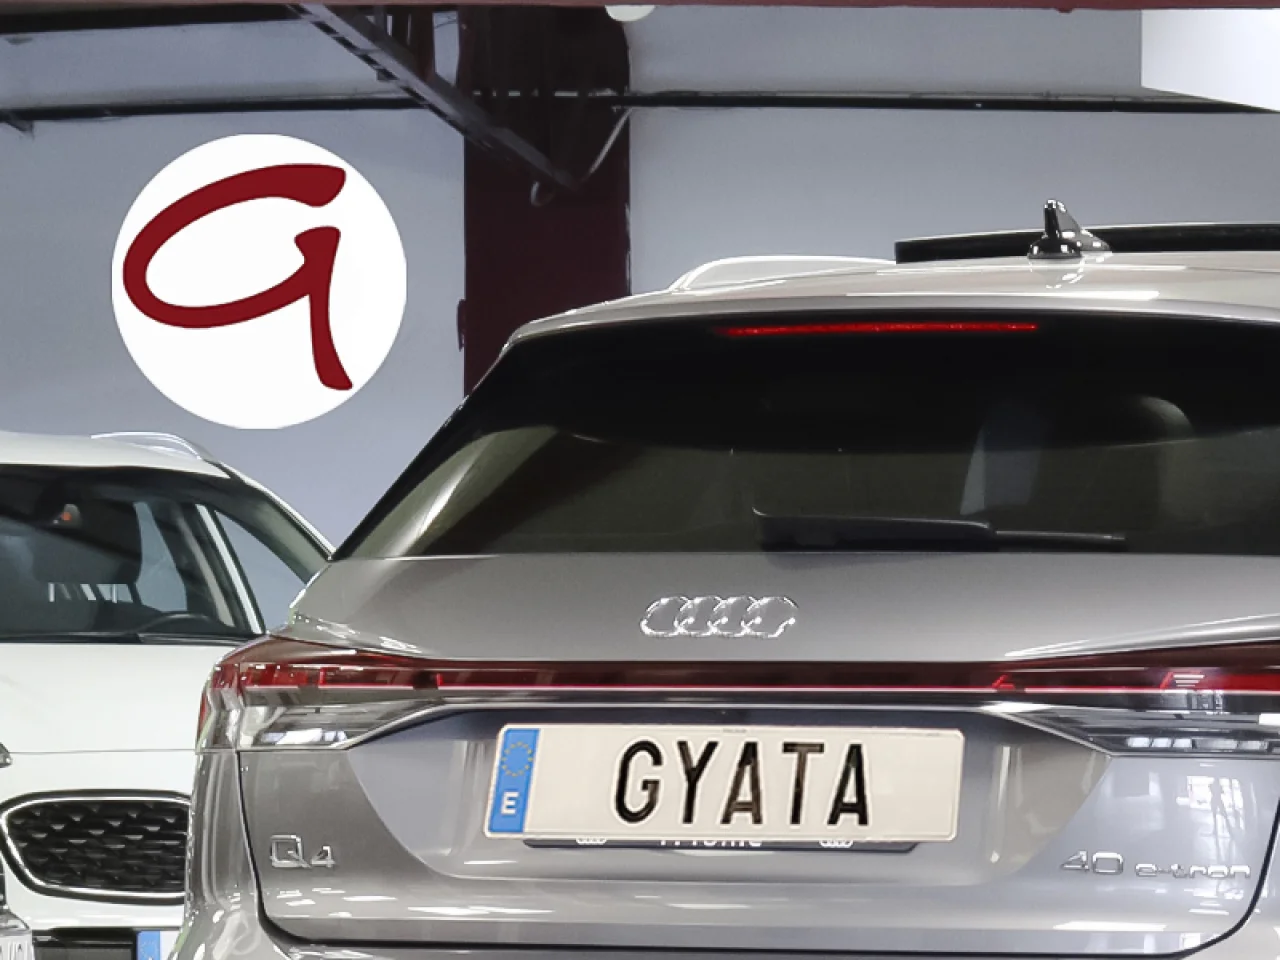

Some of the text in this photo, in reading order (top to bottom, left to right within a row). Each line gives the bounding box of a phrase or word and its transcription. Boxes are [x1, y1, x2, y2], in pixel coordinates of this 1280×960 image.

[614, 739, 870, 827] GYATA
[501, 791, 519, 814] E
[269, 834, 336, 869] Q4
[1060, 850, 1251, 878] 40 e-tron
